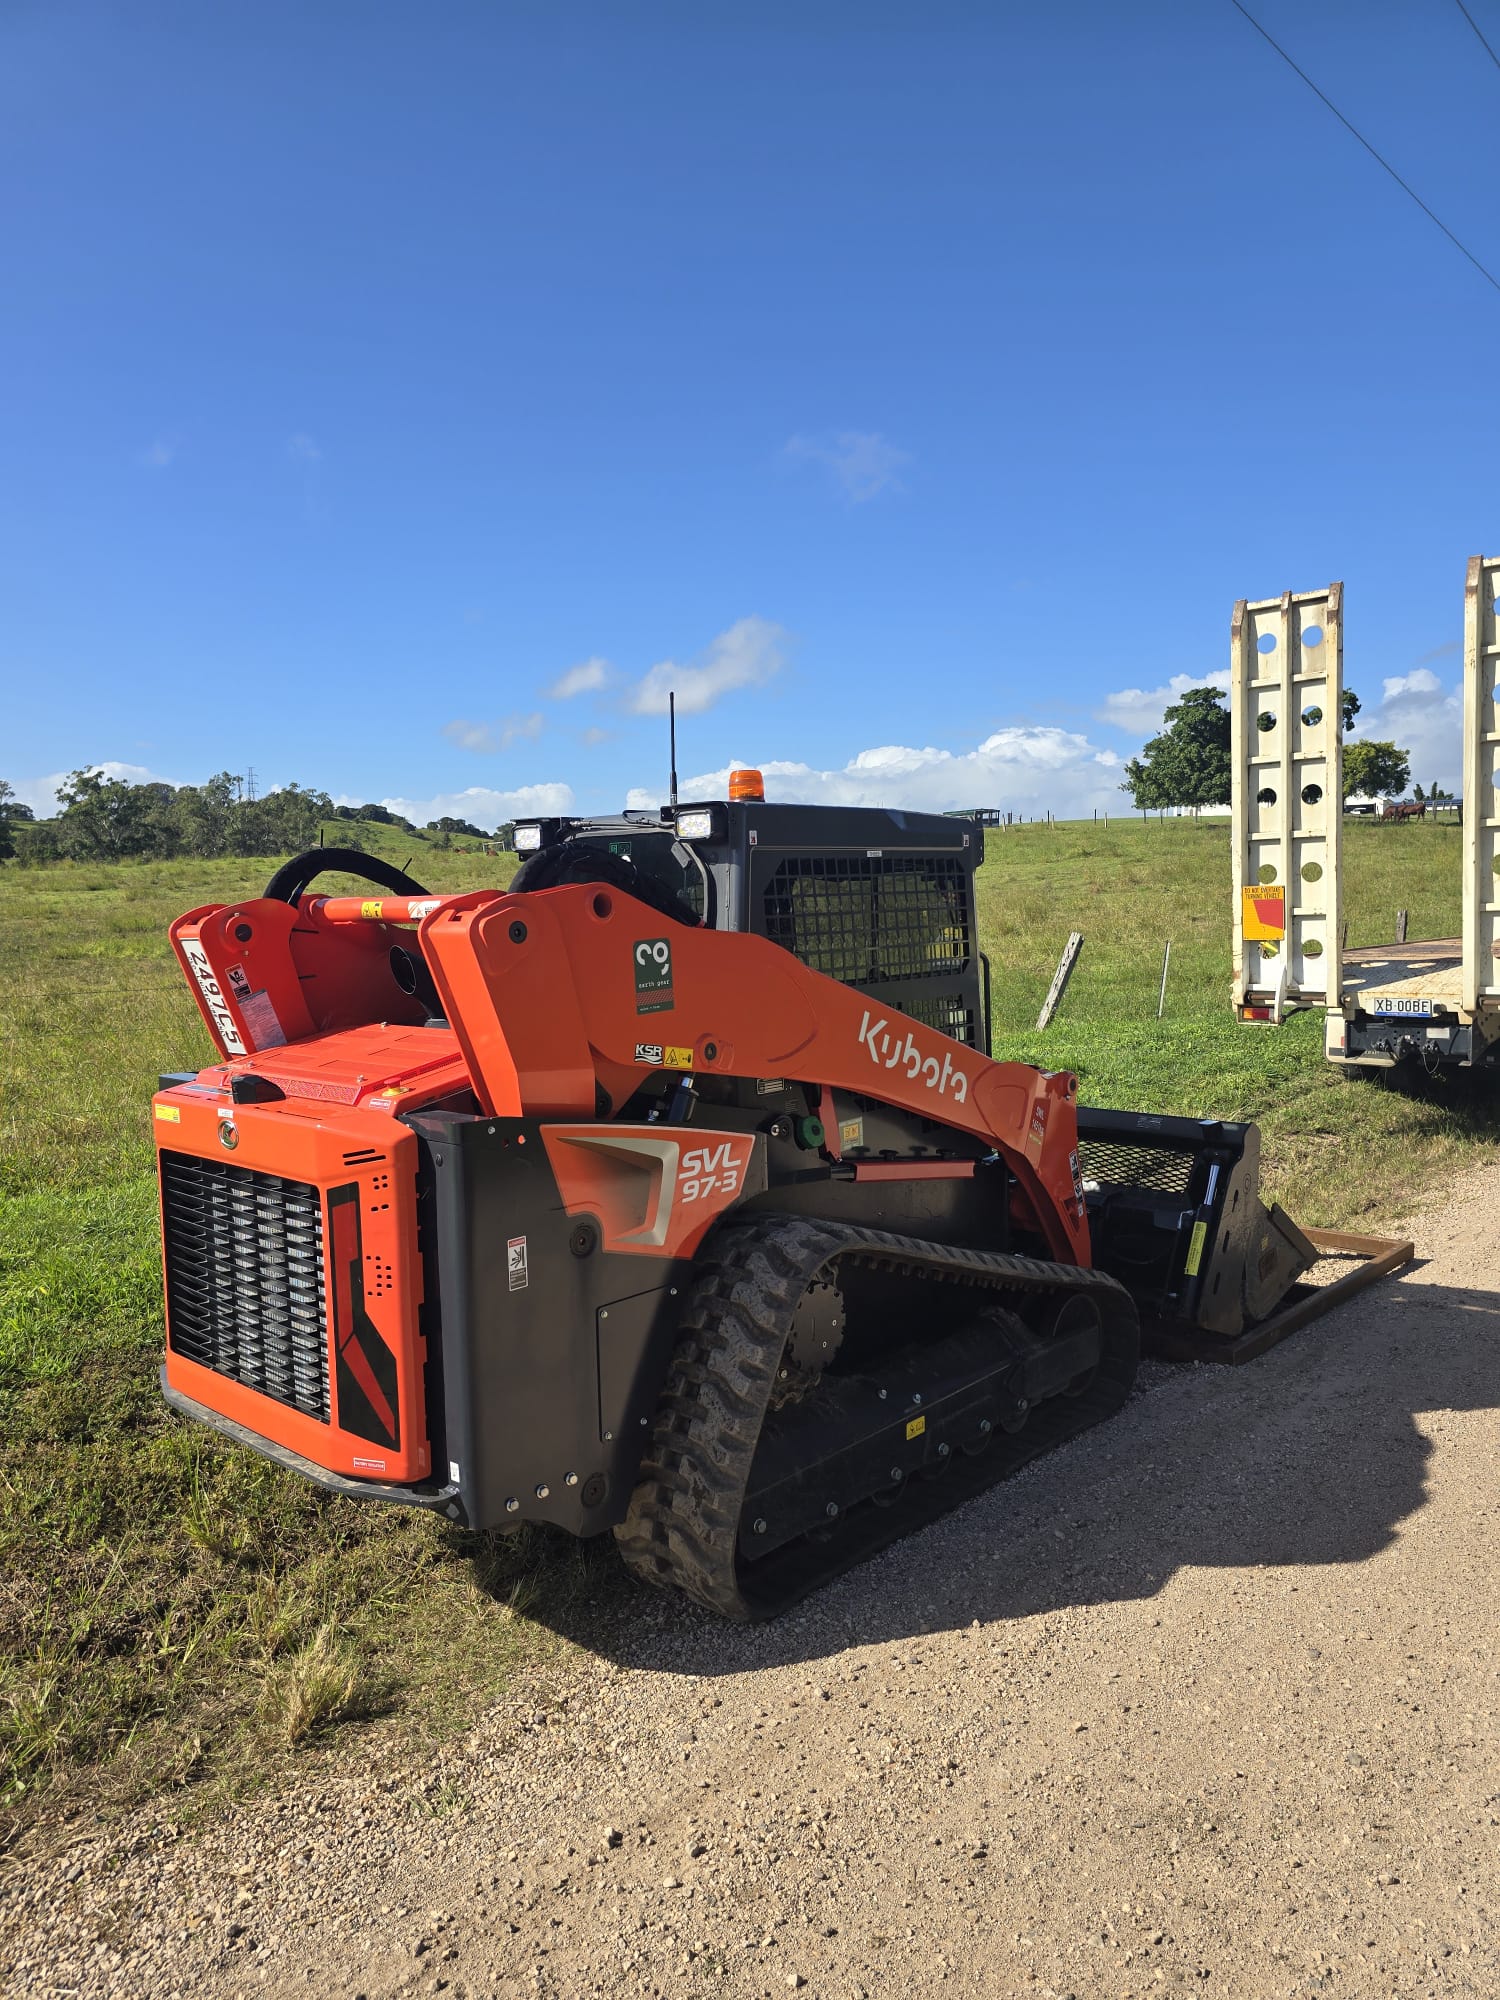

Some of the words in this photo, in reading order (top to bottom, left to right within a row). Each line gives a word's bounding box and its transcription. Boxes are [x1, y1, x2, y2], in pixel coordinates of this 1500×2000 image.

[190, 951, 242, 1044] 2497C5
[656, 979, 670, 988] gear
[635, 1044, 663, 1056] KSR
[858, 1010, 968, 1103] Kubota
[679, 1143, 741, 1180] SVL
[681, 1170, 738, 1204] 97-3
